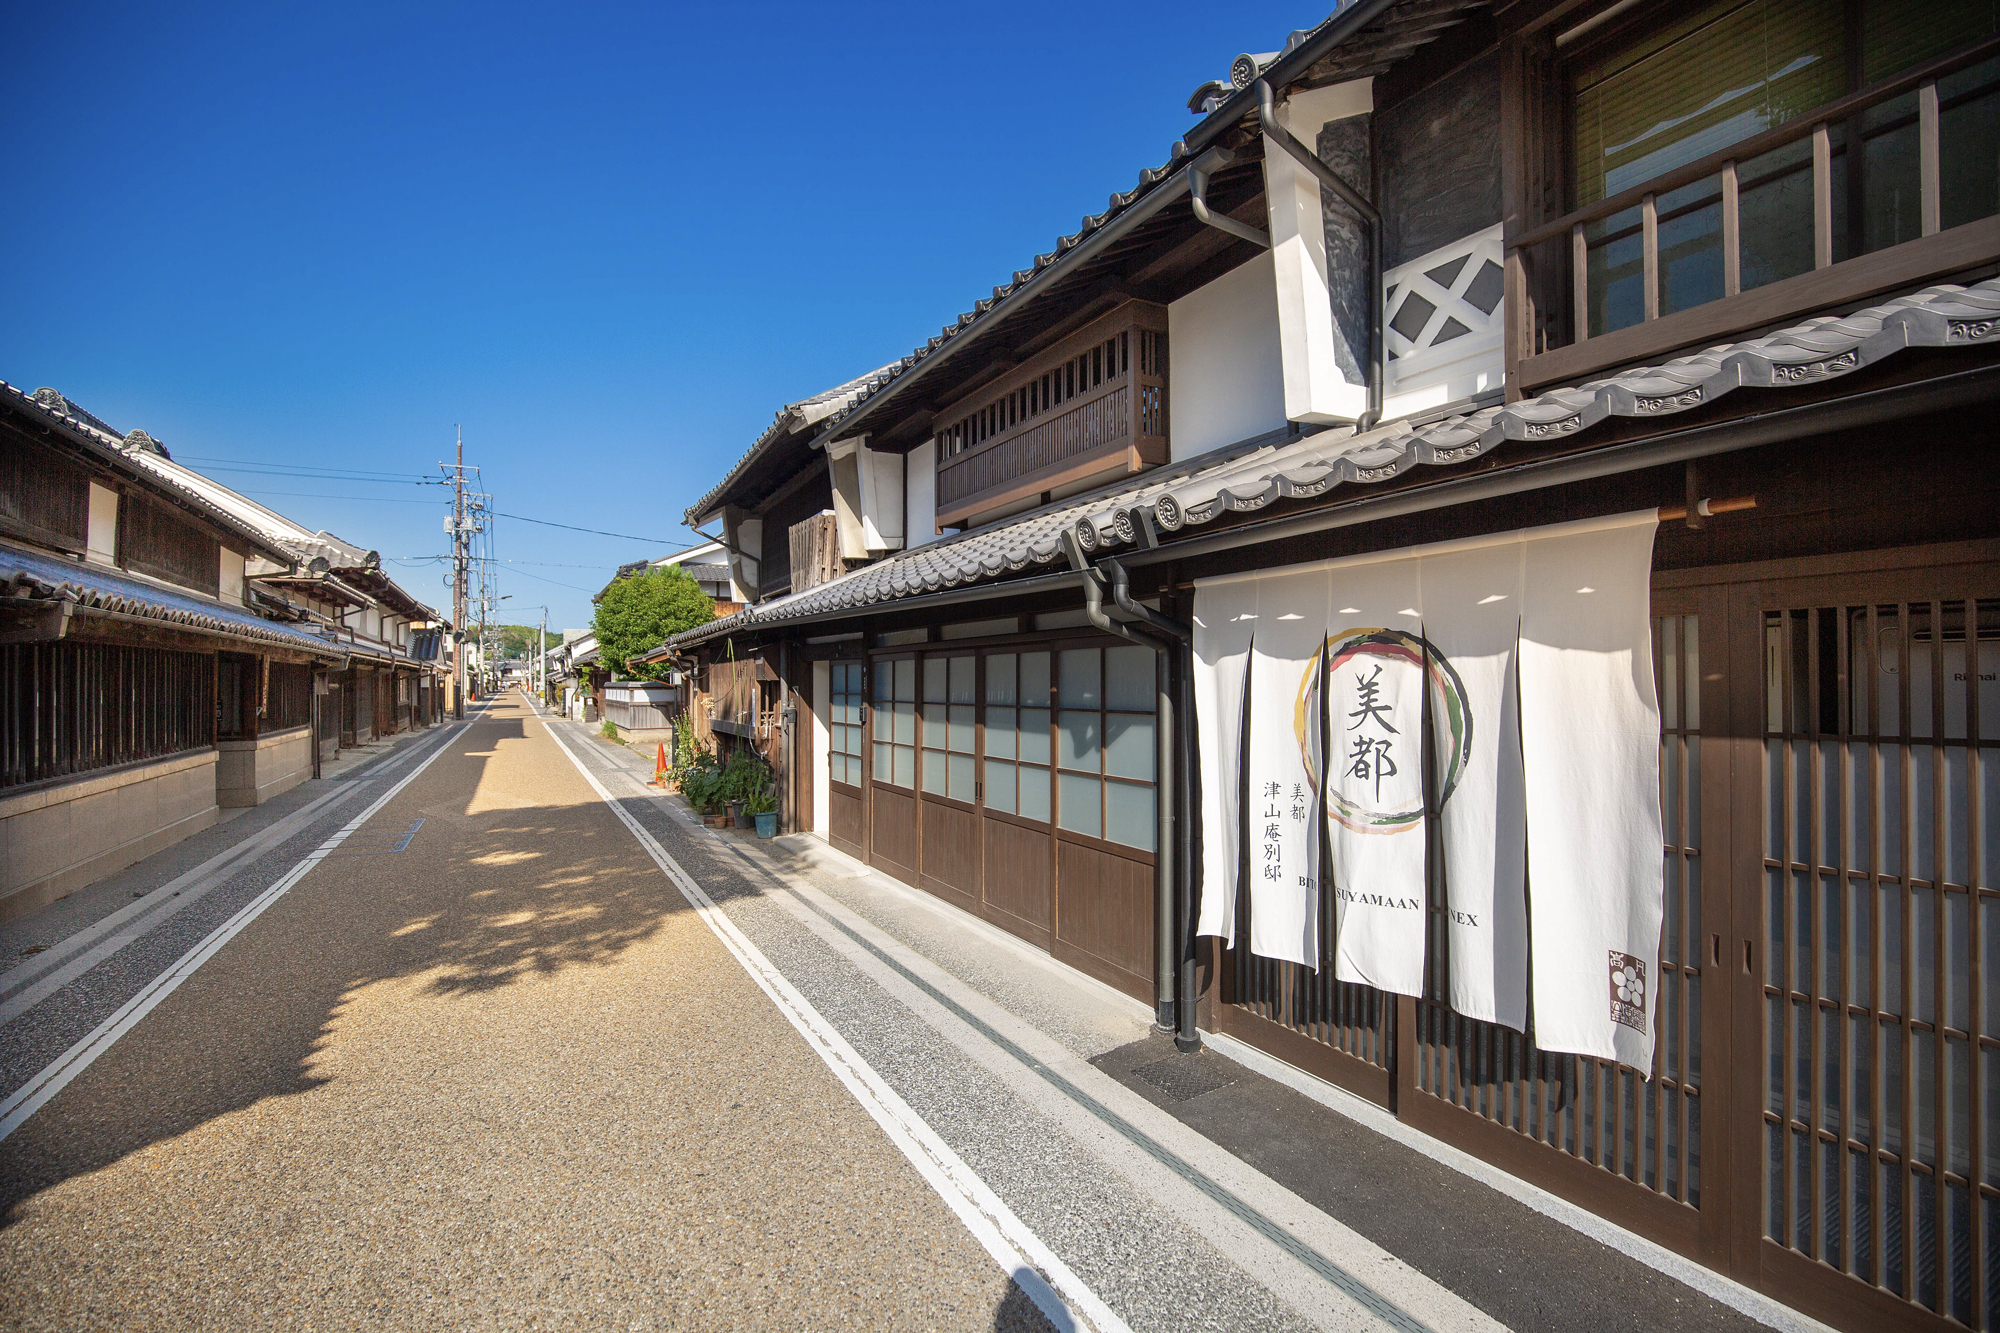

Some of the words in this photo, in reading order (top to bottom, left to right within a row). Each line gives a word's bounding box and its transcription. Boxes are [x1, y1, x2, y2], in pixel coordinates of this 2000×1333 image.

[1954, 672, 1996, 681] Rinai
[1344, 664, 1401, 803] 美都
[1263, 781, 1282, 882] 津山庵別邸
[1290, 783, 1305, 823] 美都
